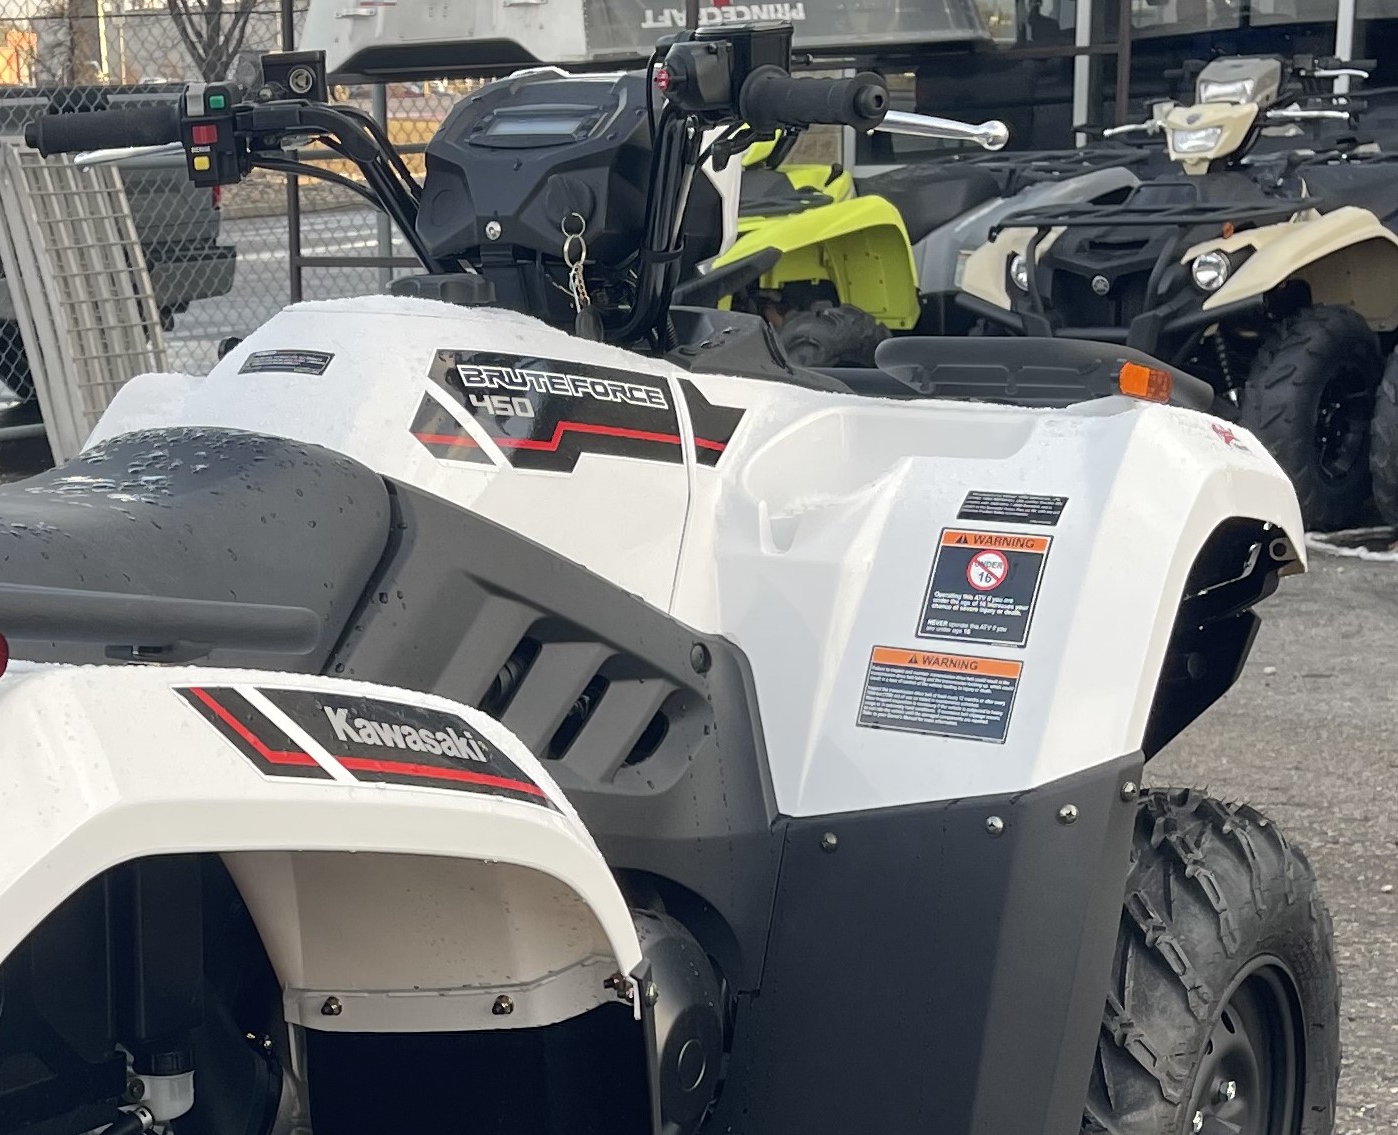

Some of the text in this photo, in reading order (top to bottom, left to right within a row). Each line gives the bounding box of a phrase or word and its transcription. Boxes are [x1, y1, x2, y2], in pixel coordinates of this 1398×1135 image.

[469, 394, 535, 418] 450
[973, 533, 1035, 549] WARNING
[978, 571, 993, 583] 16
[922, 654, 979, 671] WARNING
[323, 704, 489, 764] Kawasaki
